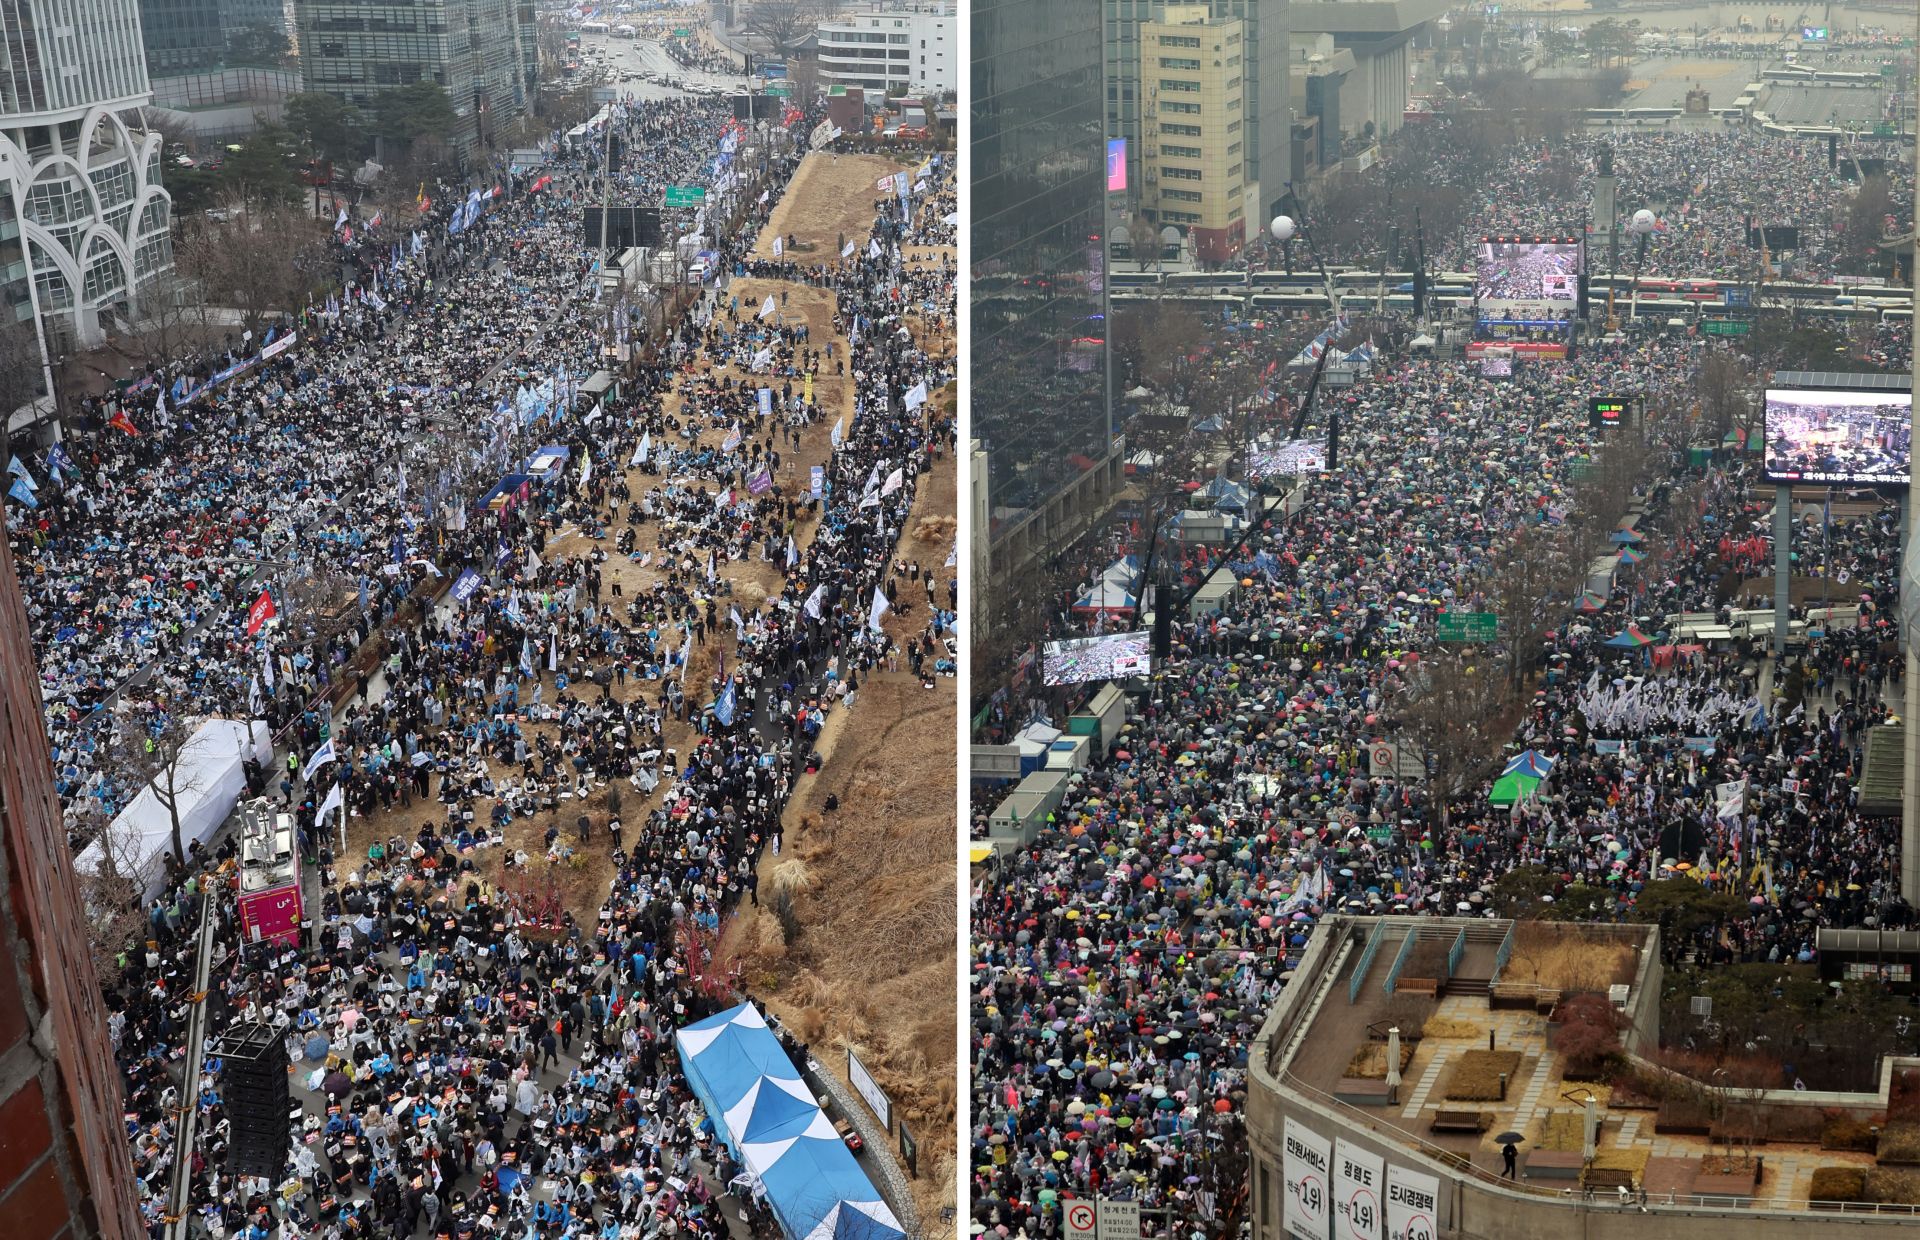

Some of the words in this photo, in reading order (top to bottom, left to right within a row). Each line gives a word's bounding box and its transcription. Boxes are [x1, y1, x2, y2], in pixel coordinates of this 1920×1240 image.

[208, 896, 216, 927] KATO
[276, 897, 291, 909] U+
[1287, 1136, 1326, 1173] 민원서비스
[1344, 1160, 1372, 1187] 청렴도
[1287, 1179, 1300, 1197] 전국
[1302, 1181, 1321, 1214] 1위
[1389, 1184, 1434, 1212] 도시경쟁력
[1337, 1200, 1350, 1219] 전국
[1353, 1200, 1373, 1233] 1위
